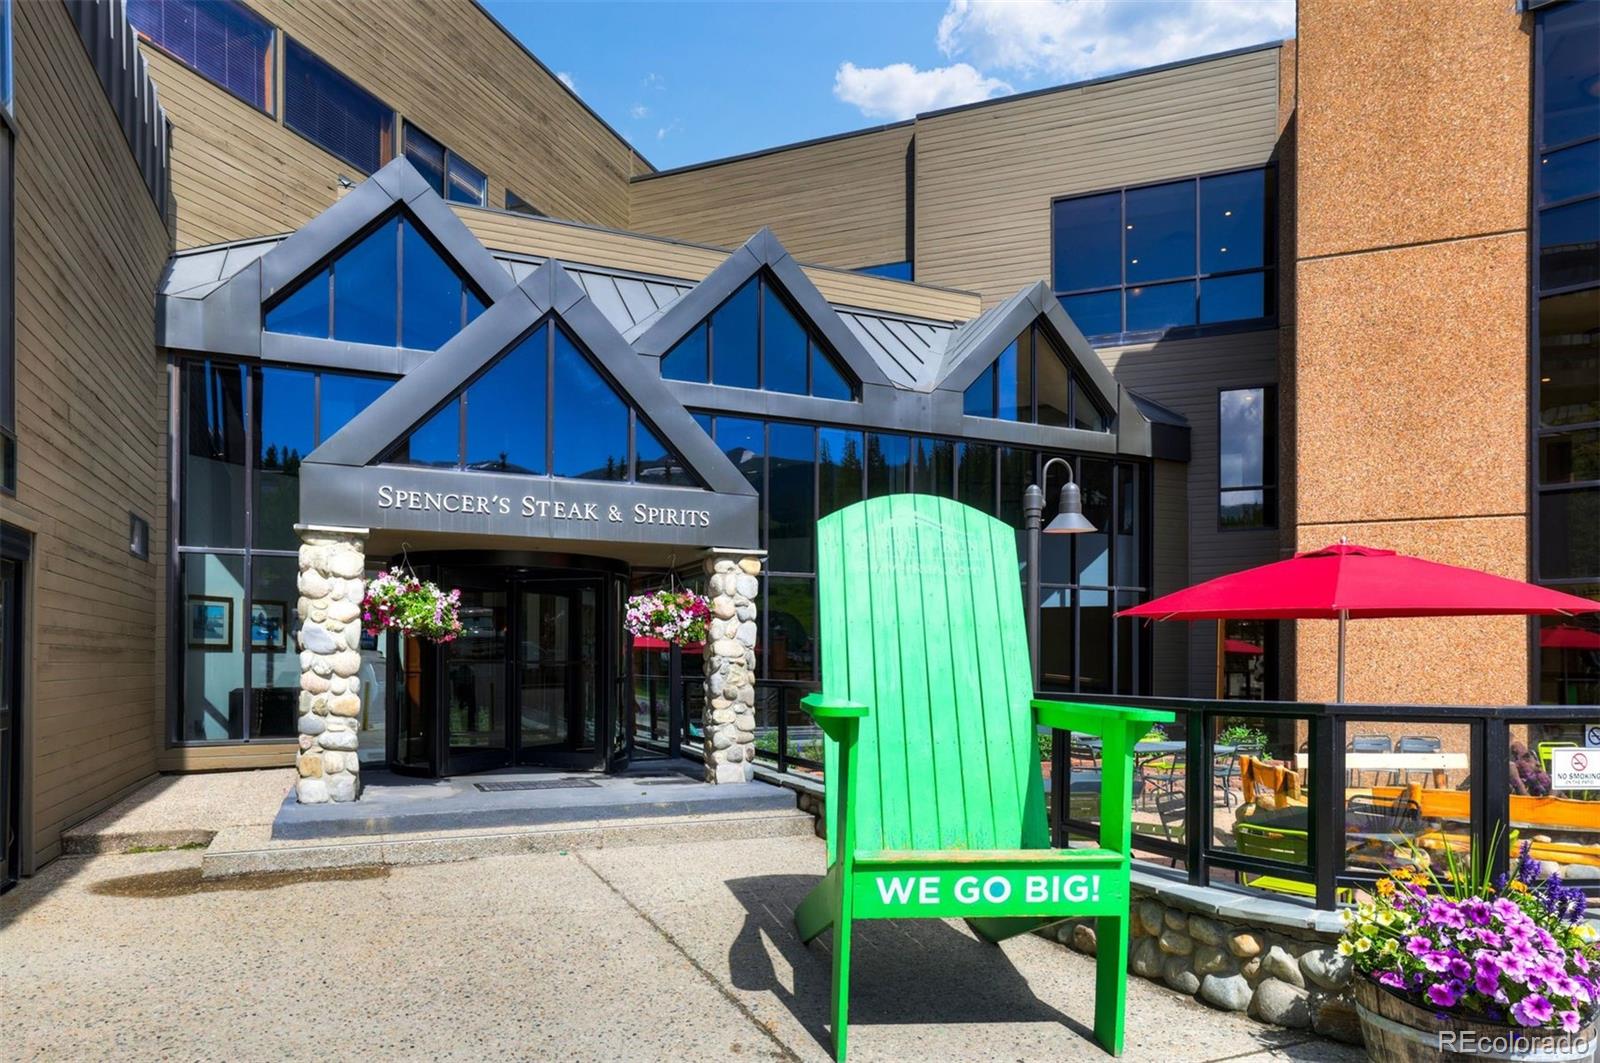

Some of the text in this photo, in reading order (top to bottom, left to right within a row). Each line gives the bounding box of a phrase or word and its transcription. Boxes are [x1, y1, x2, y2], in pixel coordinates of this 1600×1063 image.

[378, 486, 710, 527] SPENCER'S STEAK & SPIRITS
[876, 874, 1101, 905] WE GO BIG!
